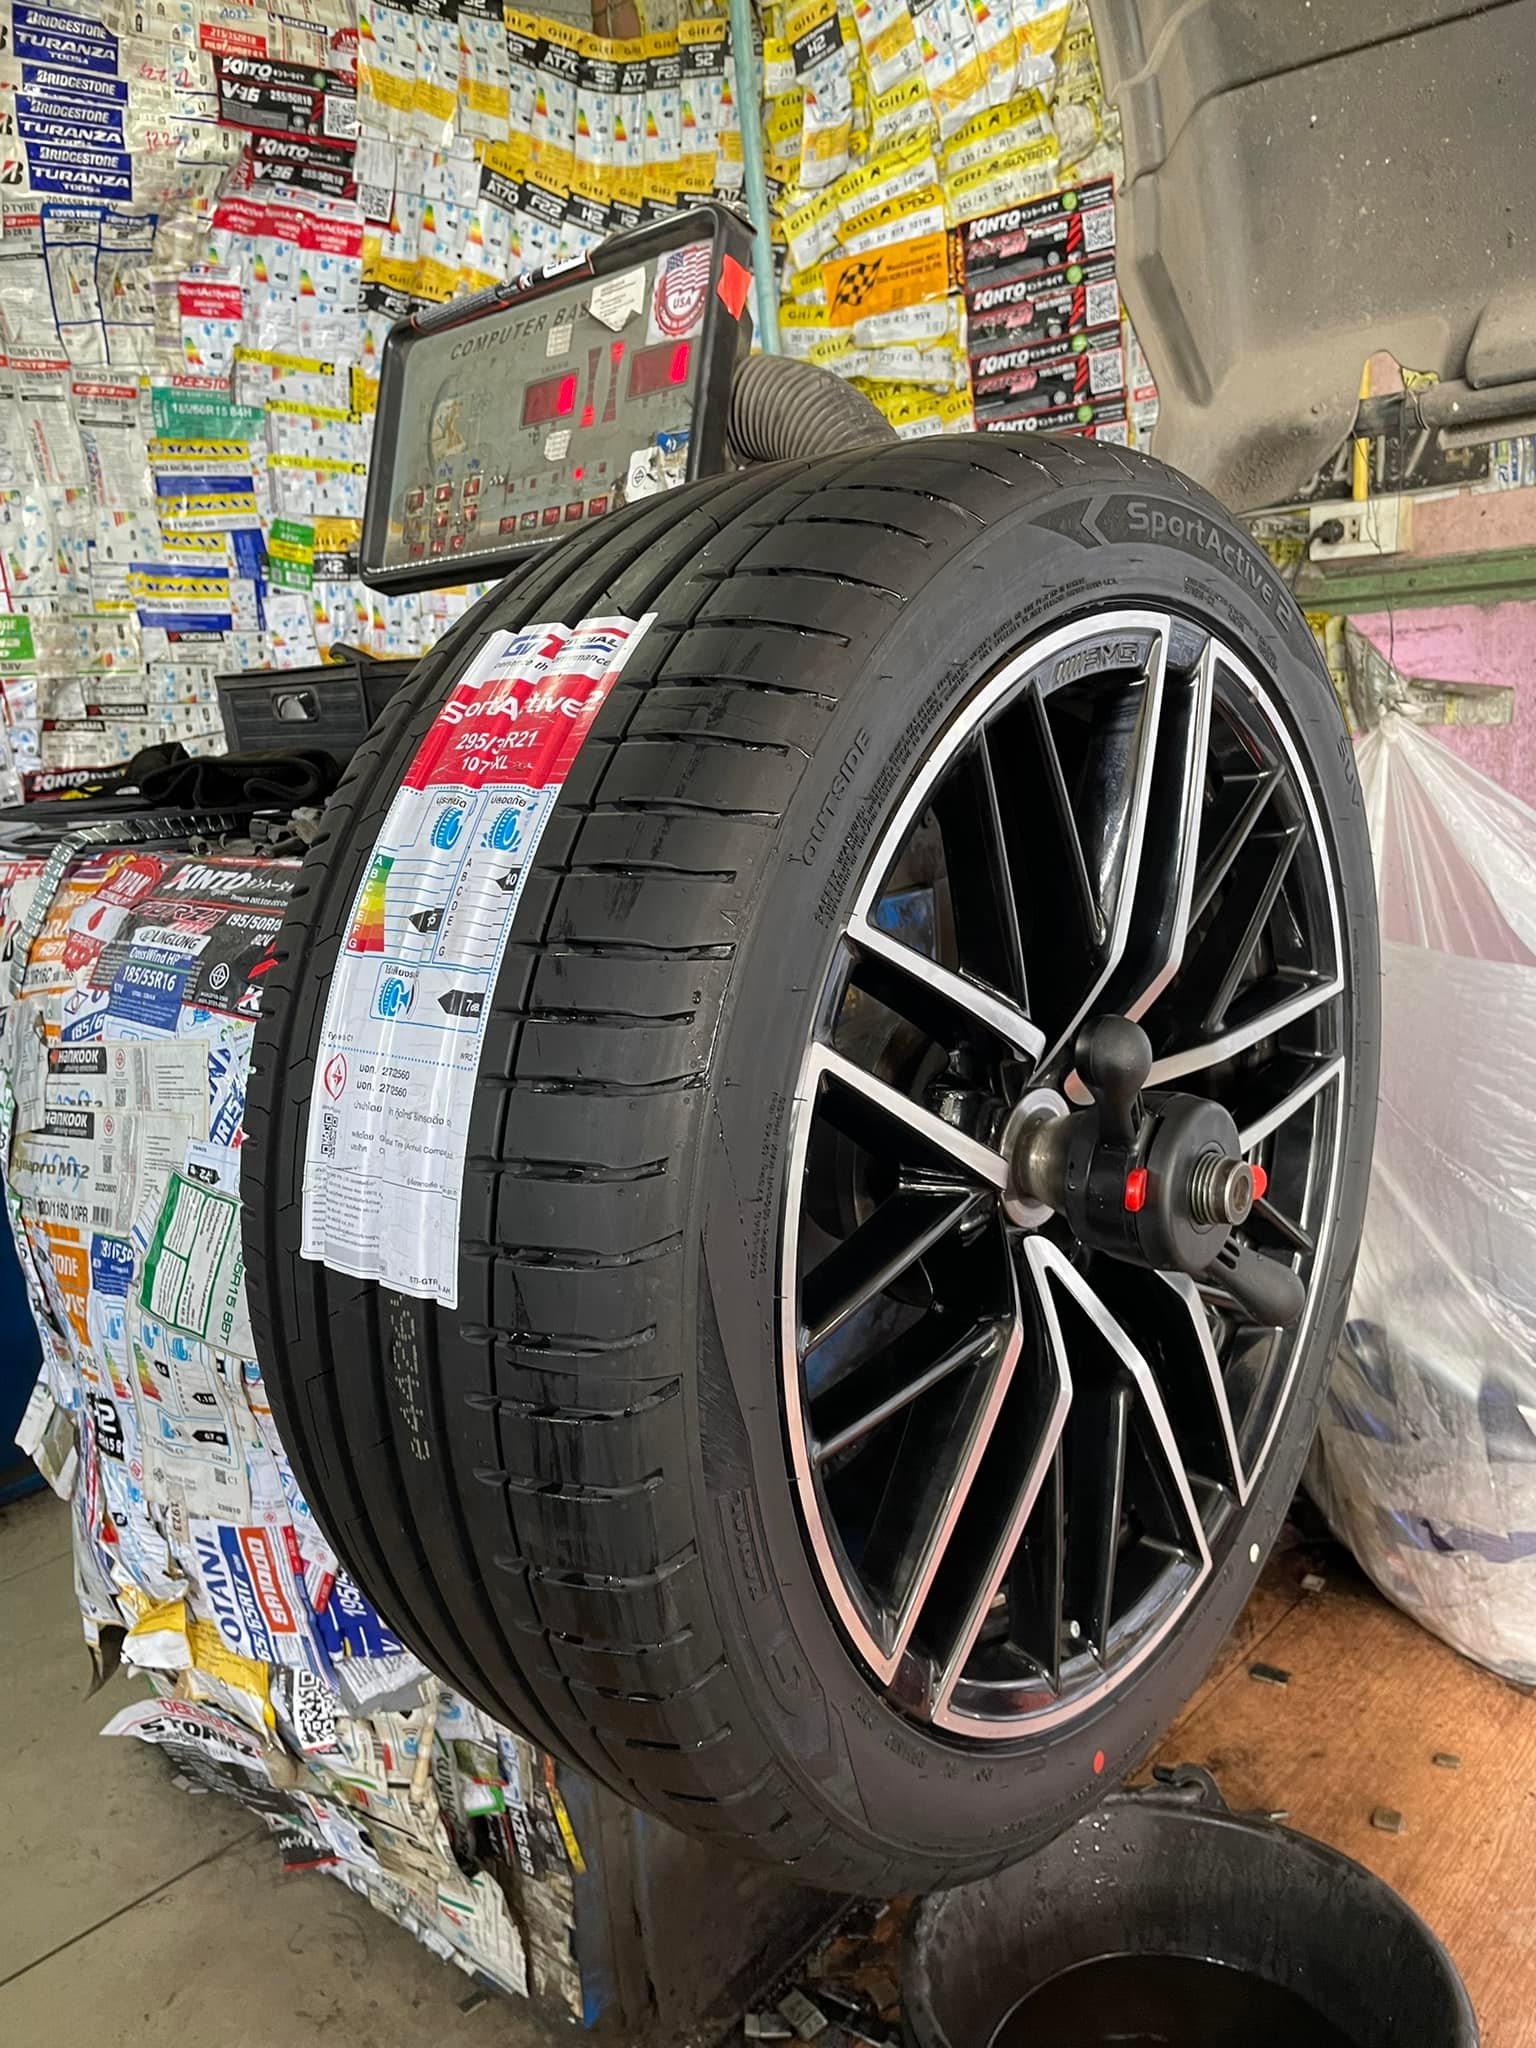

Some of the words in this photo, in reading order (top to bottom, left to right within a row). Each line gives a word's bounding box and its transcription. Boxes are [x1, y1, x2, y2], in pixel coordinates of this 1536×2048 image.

[26, 11, 107, 39] BRIDGESTONE
[688, 27, 710, 38] Giti
[794, 14, 816, 32] Giti
[548, 27, 573, 43] Giti
[16, 31, 117, 61] TURANZA
[807, 35, 827, 57] H2
[694, 52, 714, 67] S2
[37, 70, 117, 96] BRIDGESTONE
[30, 100, 110, 123] BRIDGESTONE
[878, 94, 905, 109] Giti
[20, 120, 122, 144] TURANZA
[954, 123, 983, 142] Giti
[40, 147, 120, 168] BRIDGESTONE
[256, 137, 310, 159] KINTO
[31, 166, 130, 188] TURANZA
[534, 169, 559, 188] Giti
[840, 176, 865, 194] Giti
[953, 169, 982, 188] Giti
[486, 179, 520, 205] AT70
[579, 181, 605, 198] Giti
[530, 195, 563, 219] F22
[581, 206, 605, 224] H2
[790, 208, 816, 231] Giti
[845, 212, 876, 232] Giti
[673, 295, 692, 310] USA
[788, 309, 812, 319] Giti
[450, 313, 548, 362] COMPUTER
[816, 342, 846, 357] Giti
[1126, 501, 1274, 603] SportActive
[1274, 595, 1294, 633] 2
[1082, 641, 1139, 672] AMG
[491, 755, 509, 770] XL
[32, 771, 90, 792] KINTO
[163, 863, 253, 892] KINTO
[149, 929, 202, 949] LINGLONG
[129, 946, 165, 964] CrossWind
[166, 951, 181, 966] HP
[122, 965, 177, 991] 185/55R16
[58, 1161, 91, 1180] MT2
[170, 1501, 183, 1533] 1923
[195, 1535, 243, 1645] OTANI
[232, 1573, 274, 1664] 65/65R17
